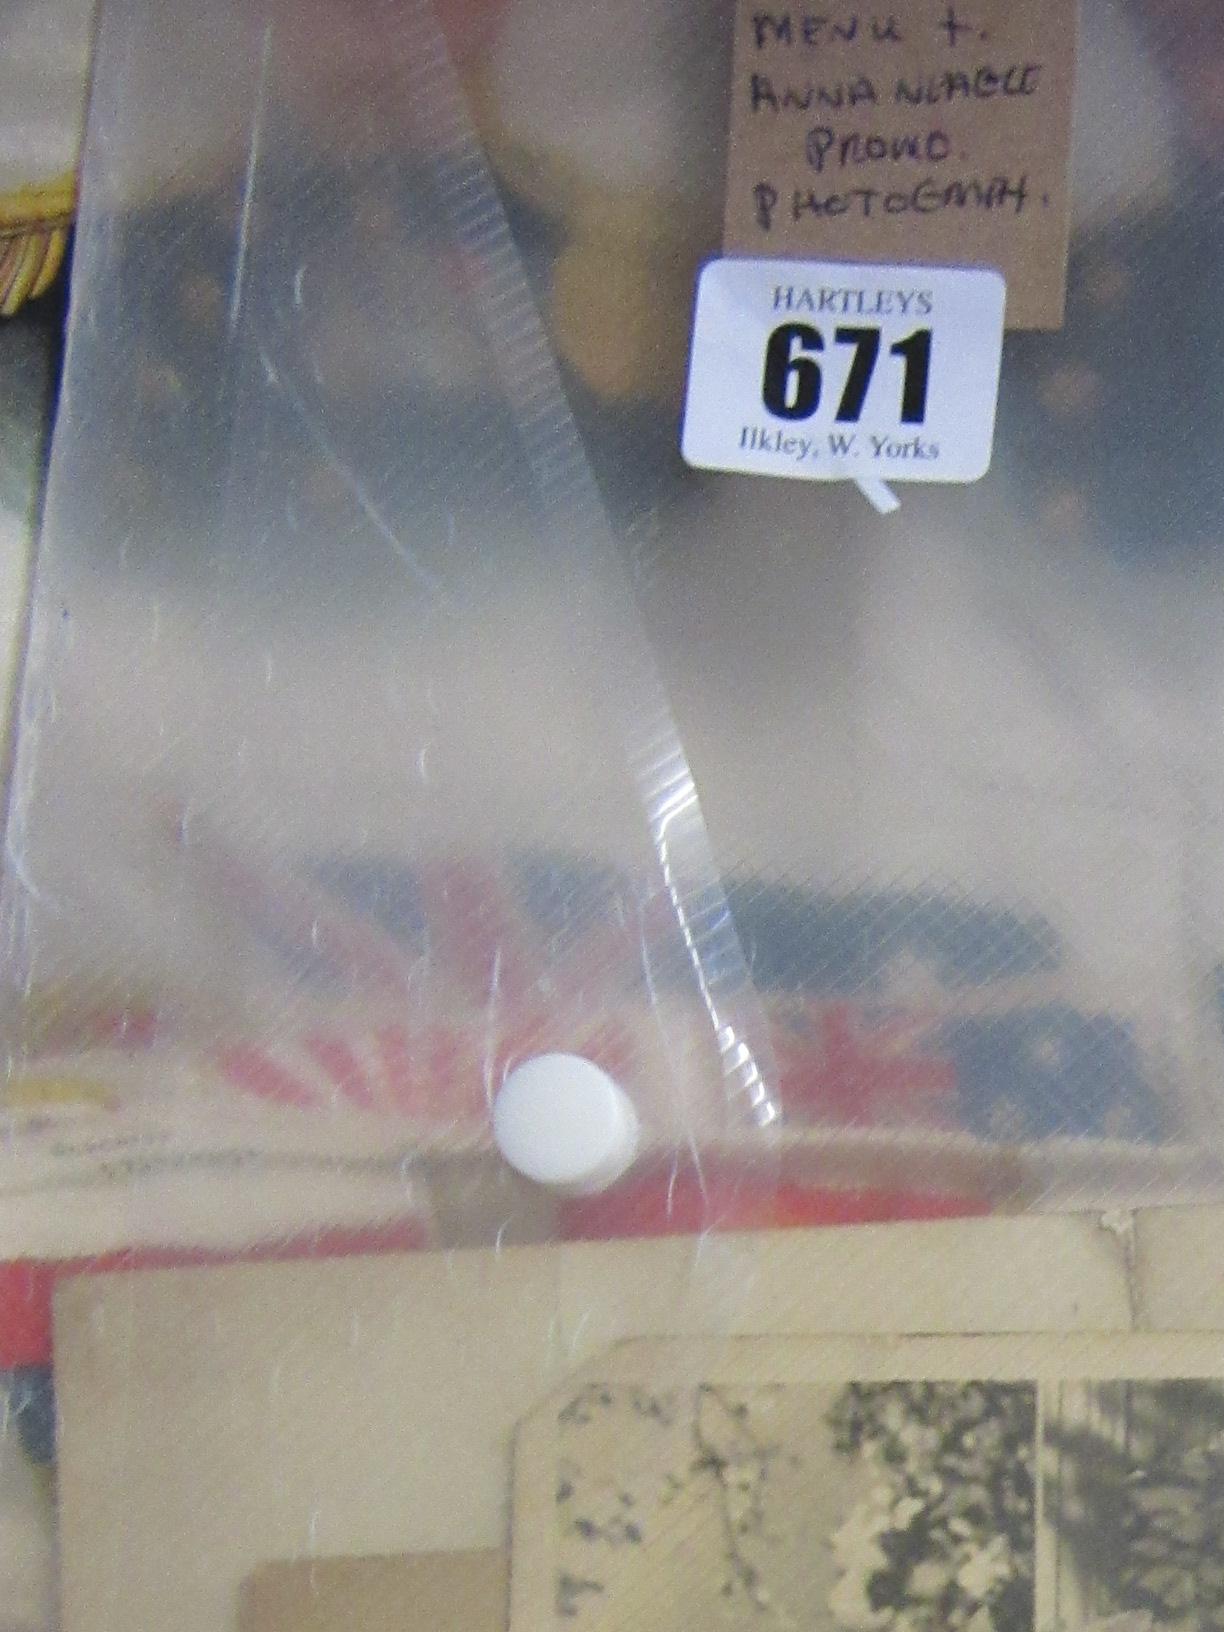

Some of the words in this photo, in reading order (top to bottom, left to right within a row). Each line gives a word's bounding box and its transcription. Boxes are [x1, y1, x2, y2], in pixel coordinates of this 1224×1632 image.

[749, 73, 879, 112] ANNA
[772, 284, 934, 316] HARTLEYS
[762, 321, 934, 425] 671
[739, 425, 820, 461] Ilkley,
[829, 432, 860, 457] W.
[871, 434, 940, 460] Yorks
